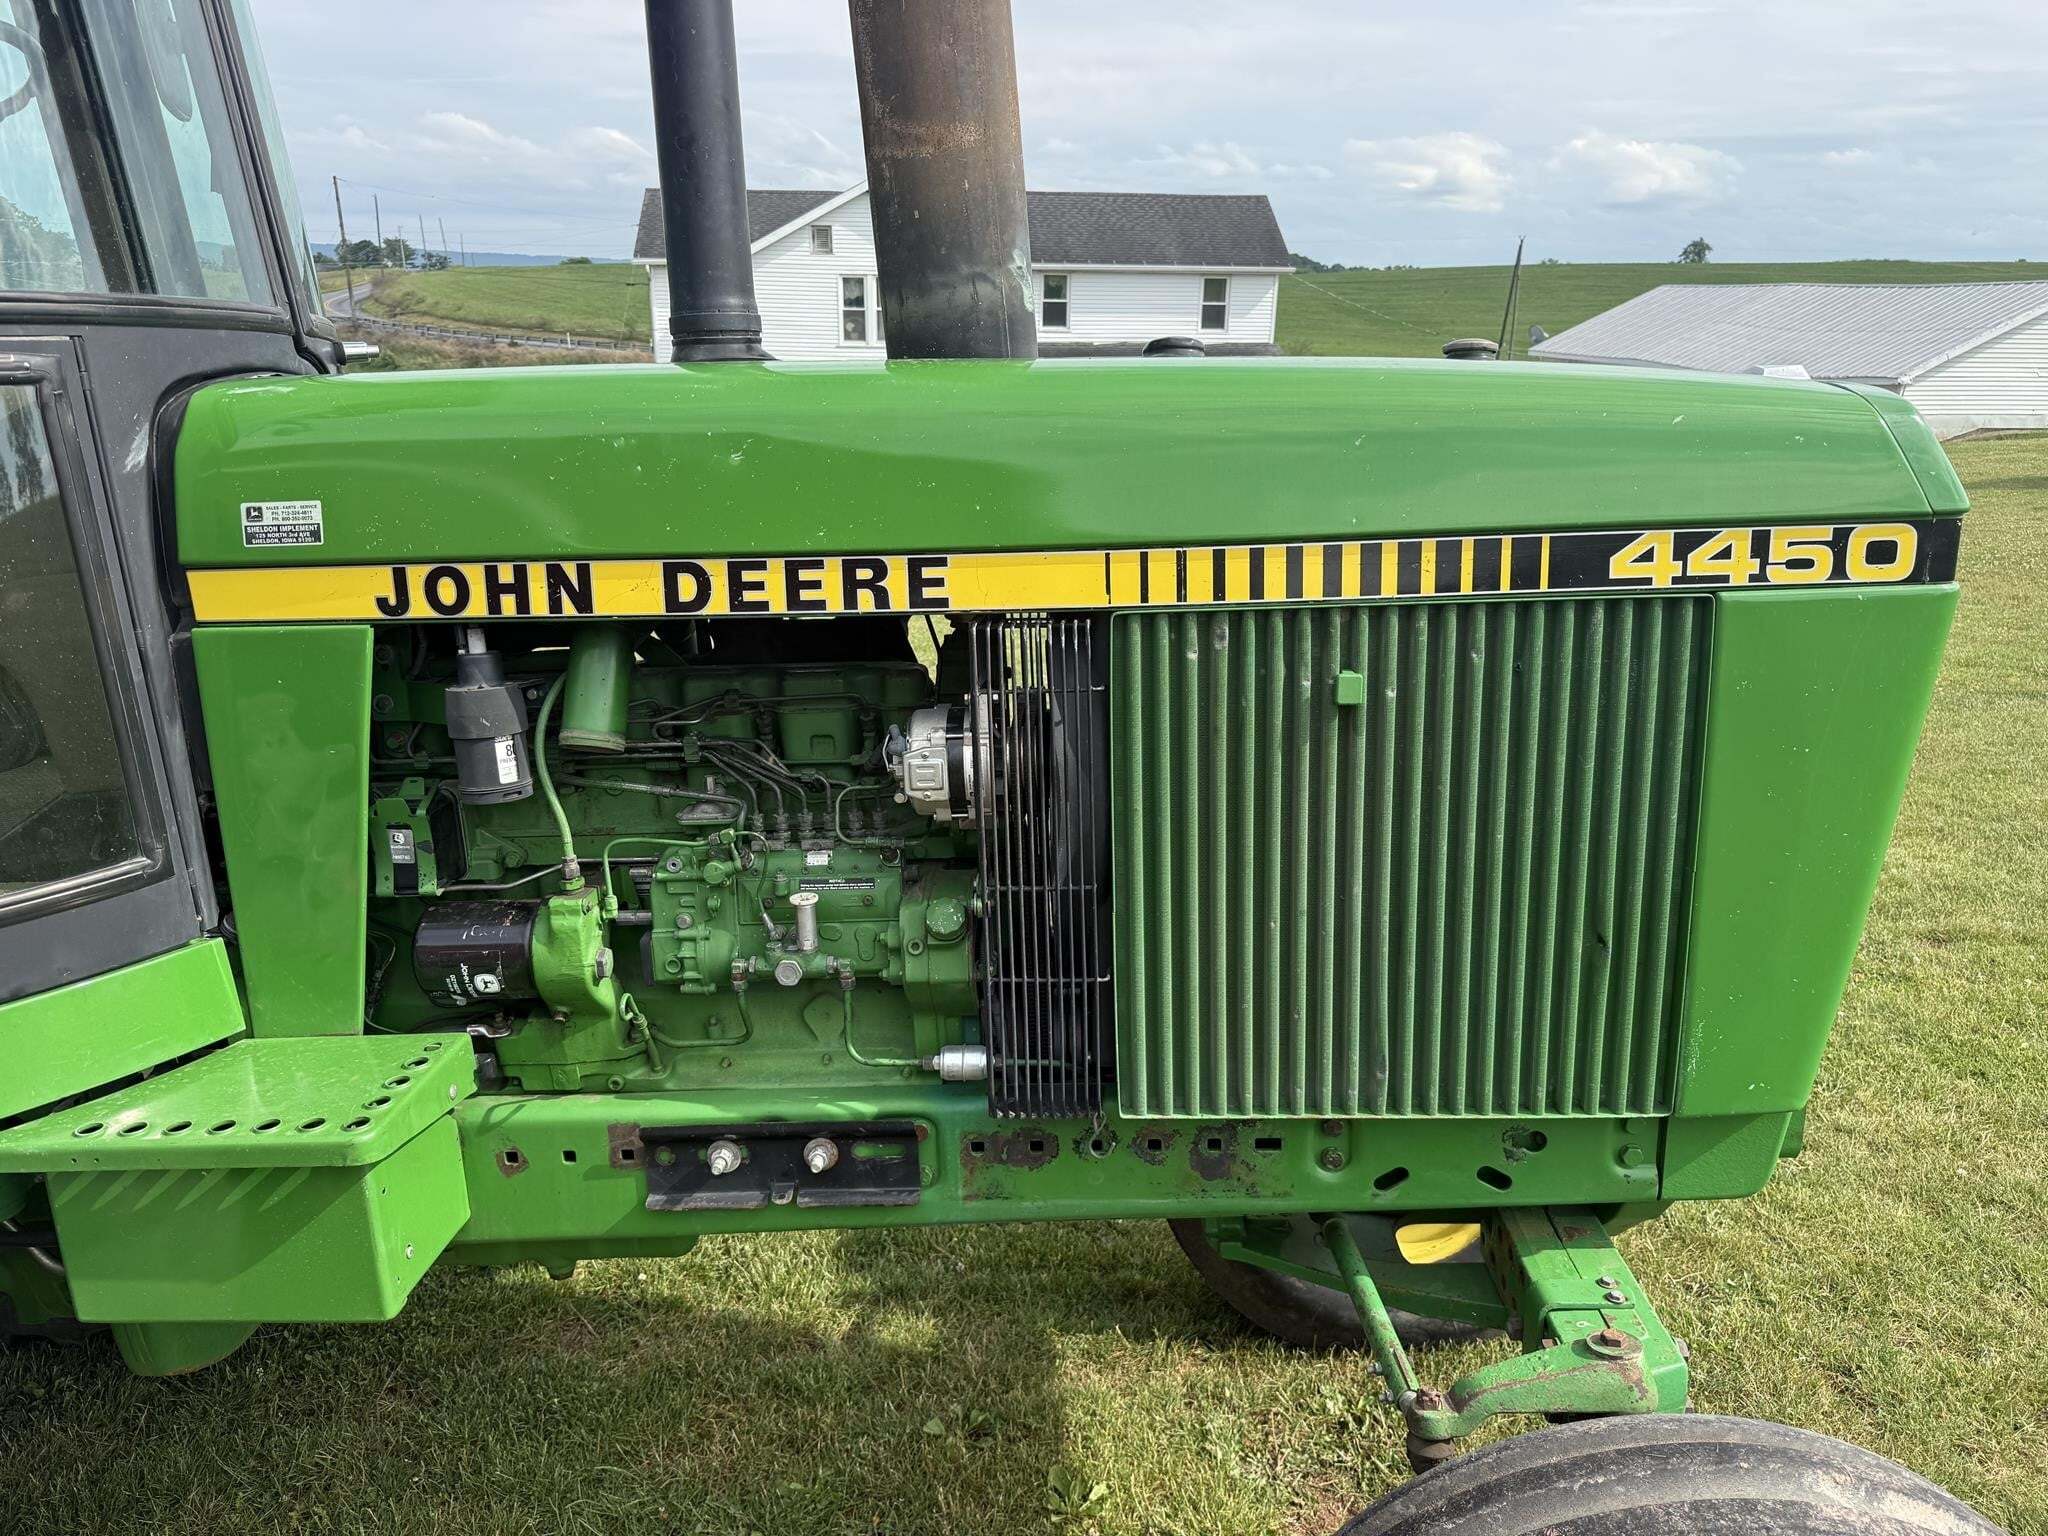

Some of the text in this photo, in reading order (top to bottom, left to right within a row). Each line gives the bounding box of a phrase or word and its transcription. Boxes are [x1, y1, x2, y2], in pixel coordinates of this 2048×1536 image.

[1608, 522, 1918, 587] 4450
[375, 556, 950, 617] JOHN DEERE
